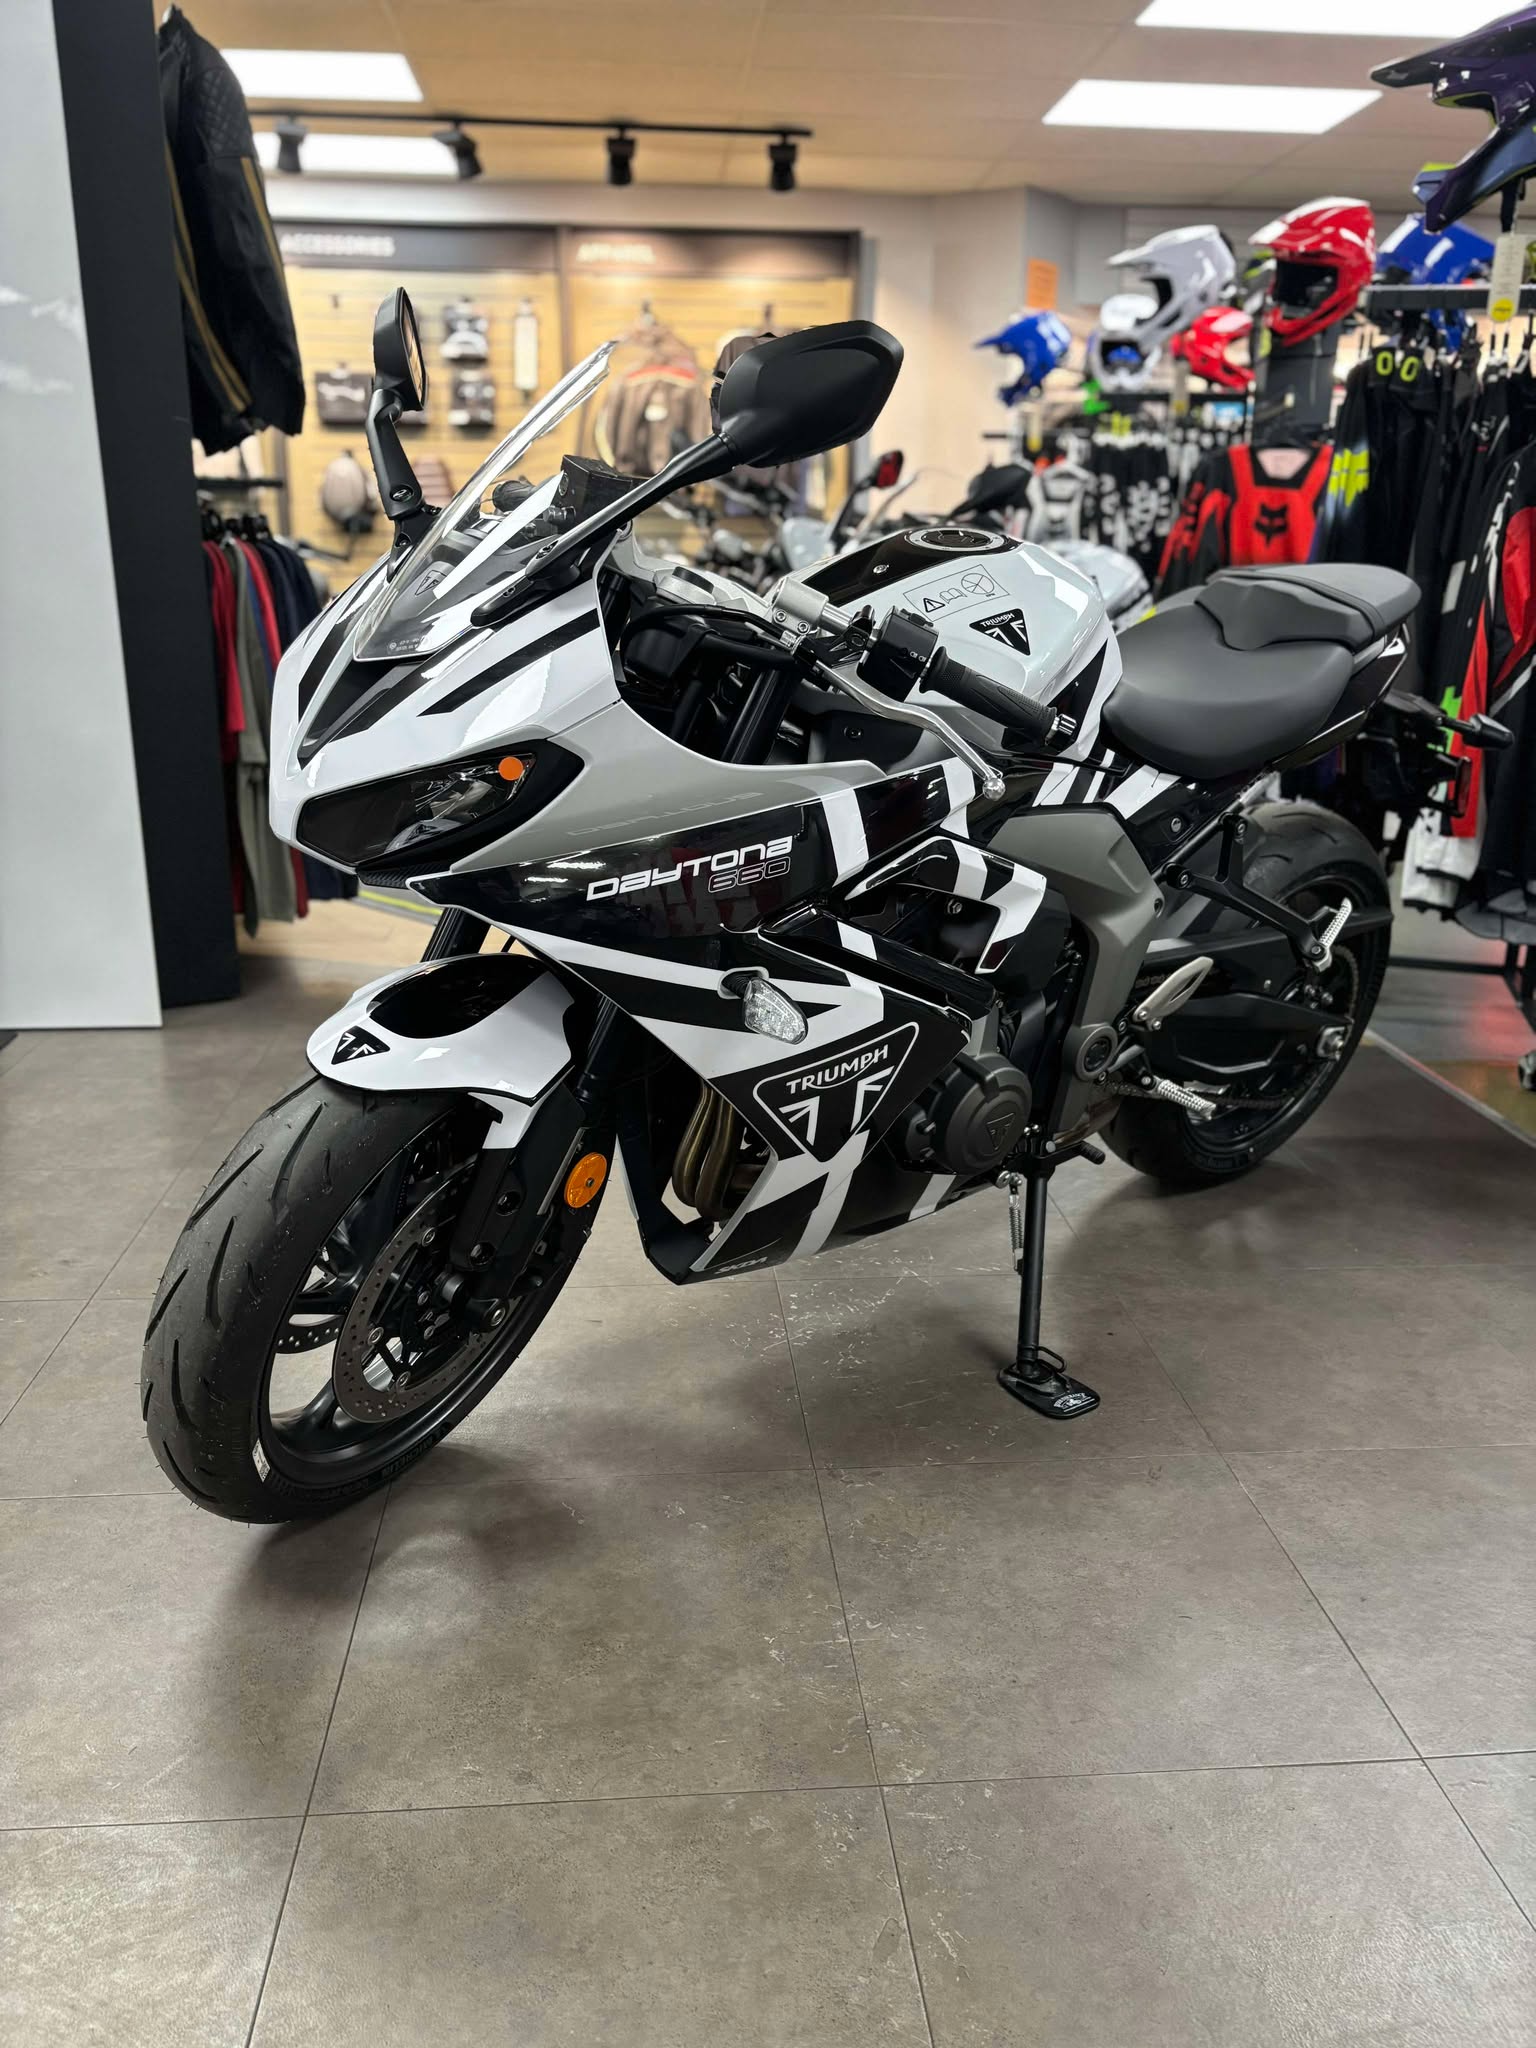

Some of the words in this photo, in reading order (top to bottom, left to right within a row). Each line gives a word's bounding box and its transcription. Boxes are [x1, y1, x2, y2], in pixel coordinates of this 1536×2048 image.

[980, 612, 1015, 628] TRIUMPH
[708, 856, 791, 893] 660
[786, 1044, 889, 1094] TRIUMPH
